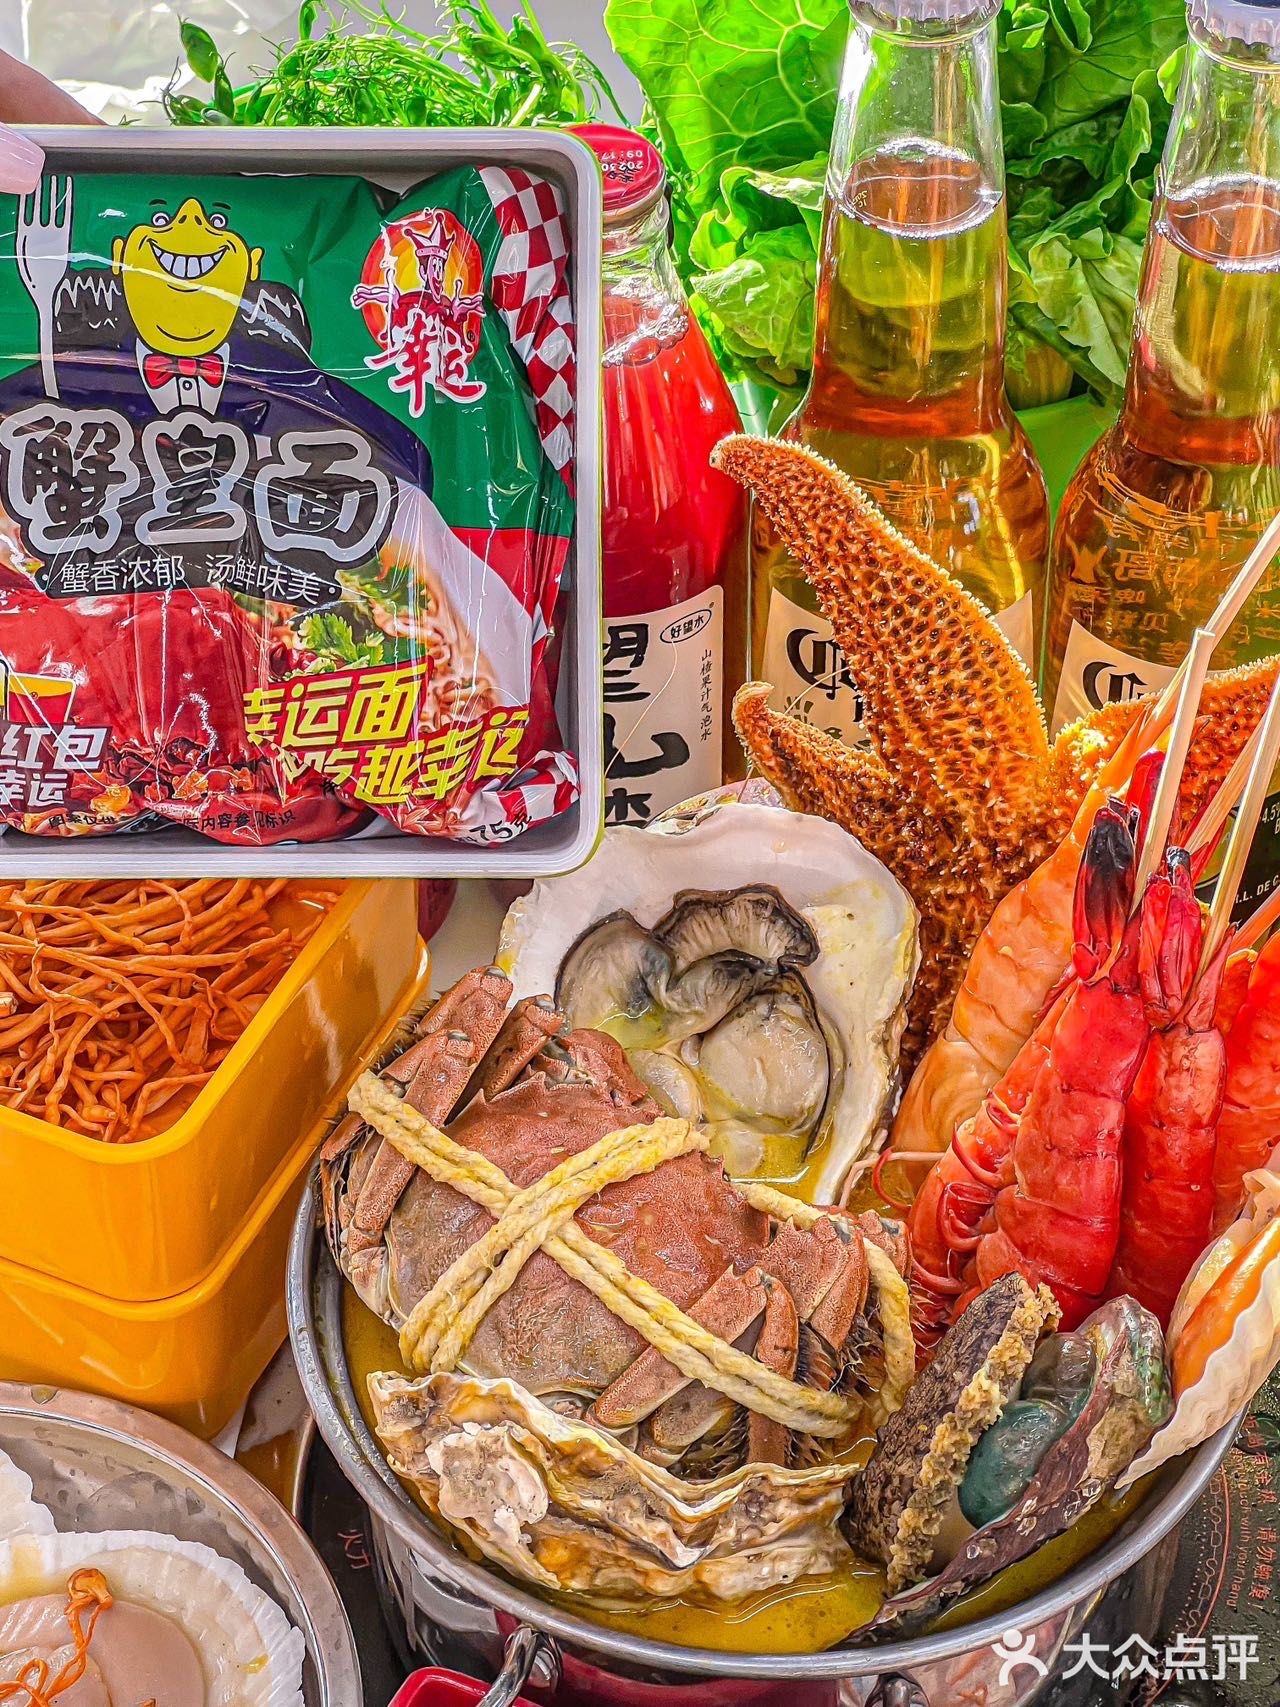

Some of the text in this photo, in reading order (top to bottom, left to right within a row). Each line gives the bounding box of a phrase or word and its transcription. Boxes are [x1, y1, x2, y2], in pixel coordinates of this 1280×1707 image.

[60, 553, 320, 605] 蟹香浓郁 汤鲜味美
[669, 614, 705, 640] 好望水
[0, 724, 108, 770] 红包
[1239, 1516, 1251, 1542] with
[1236, 1546, 1252, 1574] your
